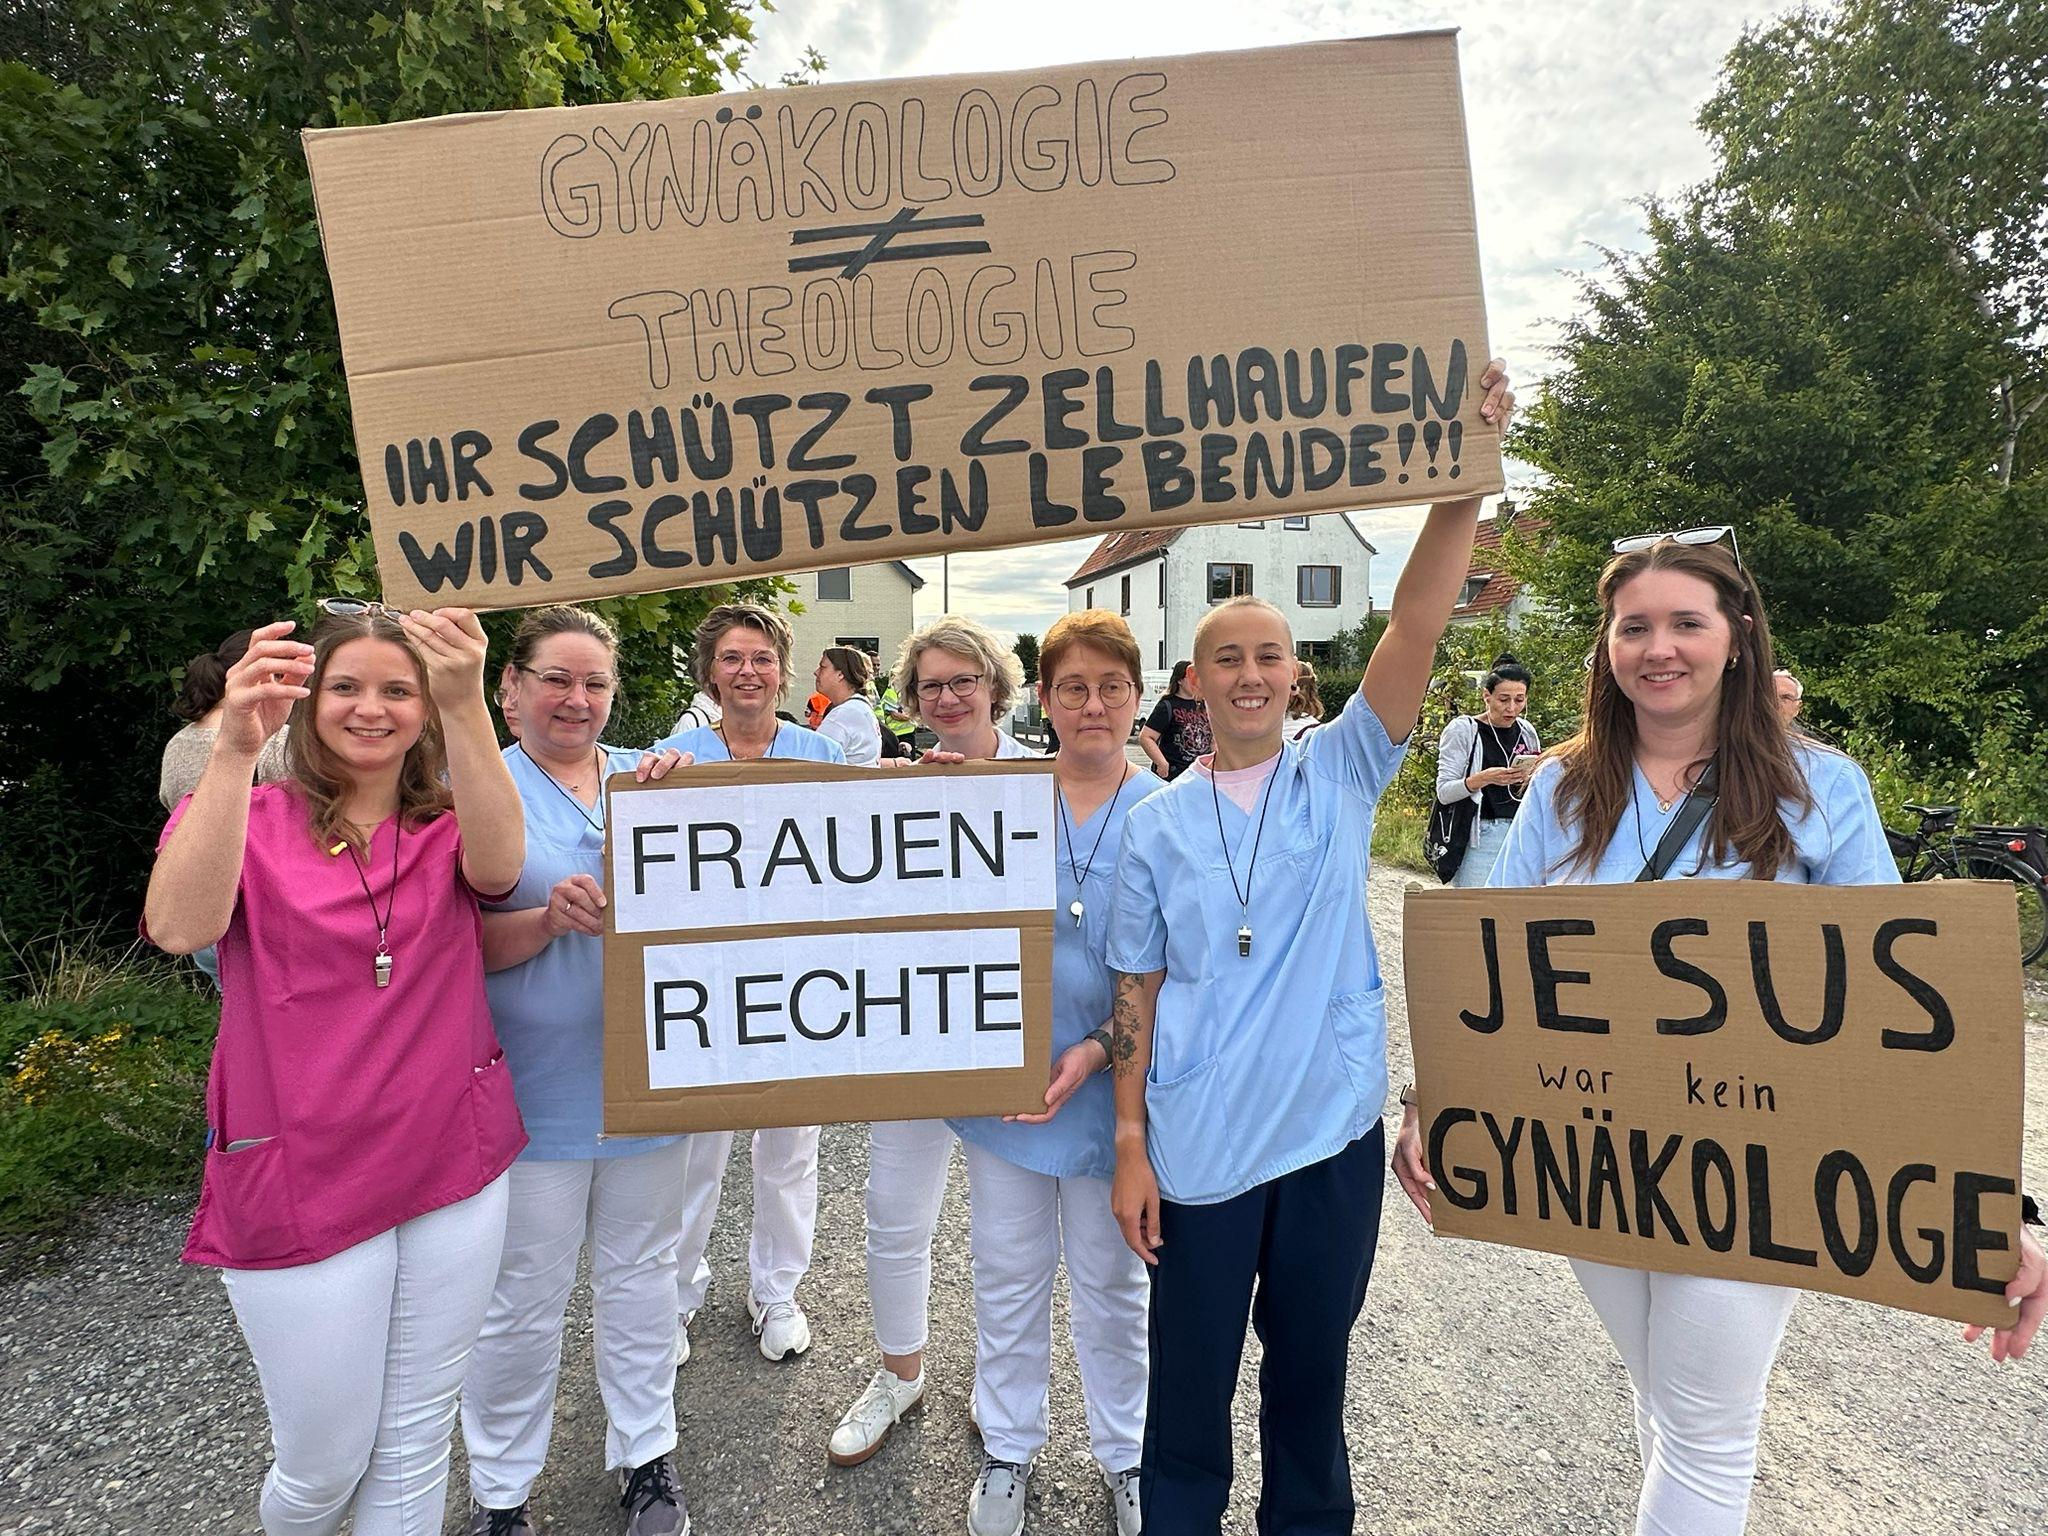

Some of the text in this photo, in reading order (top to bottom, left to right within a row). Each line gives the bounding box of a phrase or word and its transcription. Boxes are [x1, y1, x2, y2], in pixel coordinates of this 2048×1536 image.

[541, 74, 1176, 238] GYNÄKOLOGIE
[608, 250, 1137, 389] THEOLOGIE
[385, 339, 1468, 507] IHR SCHÜTZT ZELLHAUFEN
[399, 420, 1463, 594] WIR SCHÜTZEN LEBENDE!!!
[632, 811, 1038, 894] FRAUEN-
[654, 963, 1021, 1051] RECHTE
[1459, 918, 1955, 1052] JESUS
[1537, 1062, 1775, 1112] war kein
[1428, 1107, 2016, 1296] GYNÄKOLOGE
